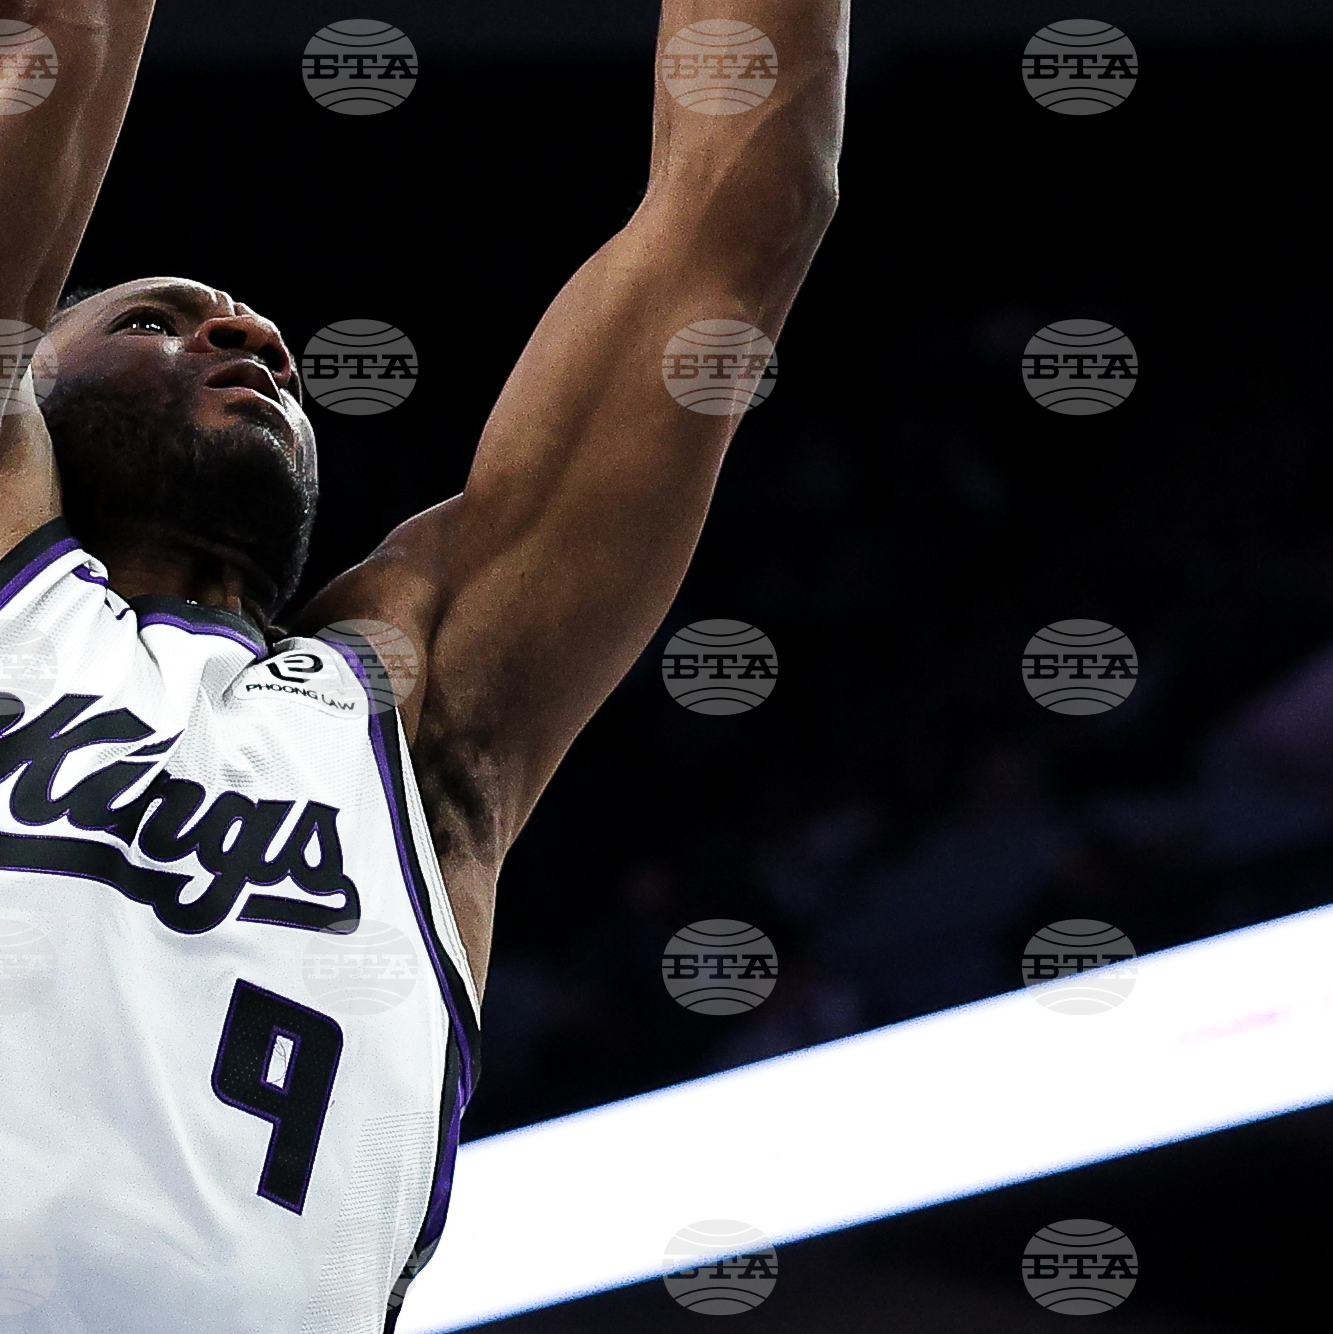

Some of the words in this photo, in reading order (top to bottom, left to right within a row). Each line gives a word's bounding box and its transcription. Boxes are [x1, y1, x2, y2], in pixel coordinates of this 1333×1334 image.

[246, 683, 318, 700] PHOONG
[322, 694, 355, 711] LAW
[211, 978, 344, 1216] 9
